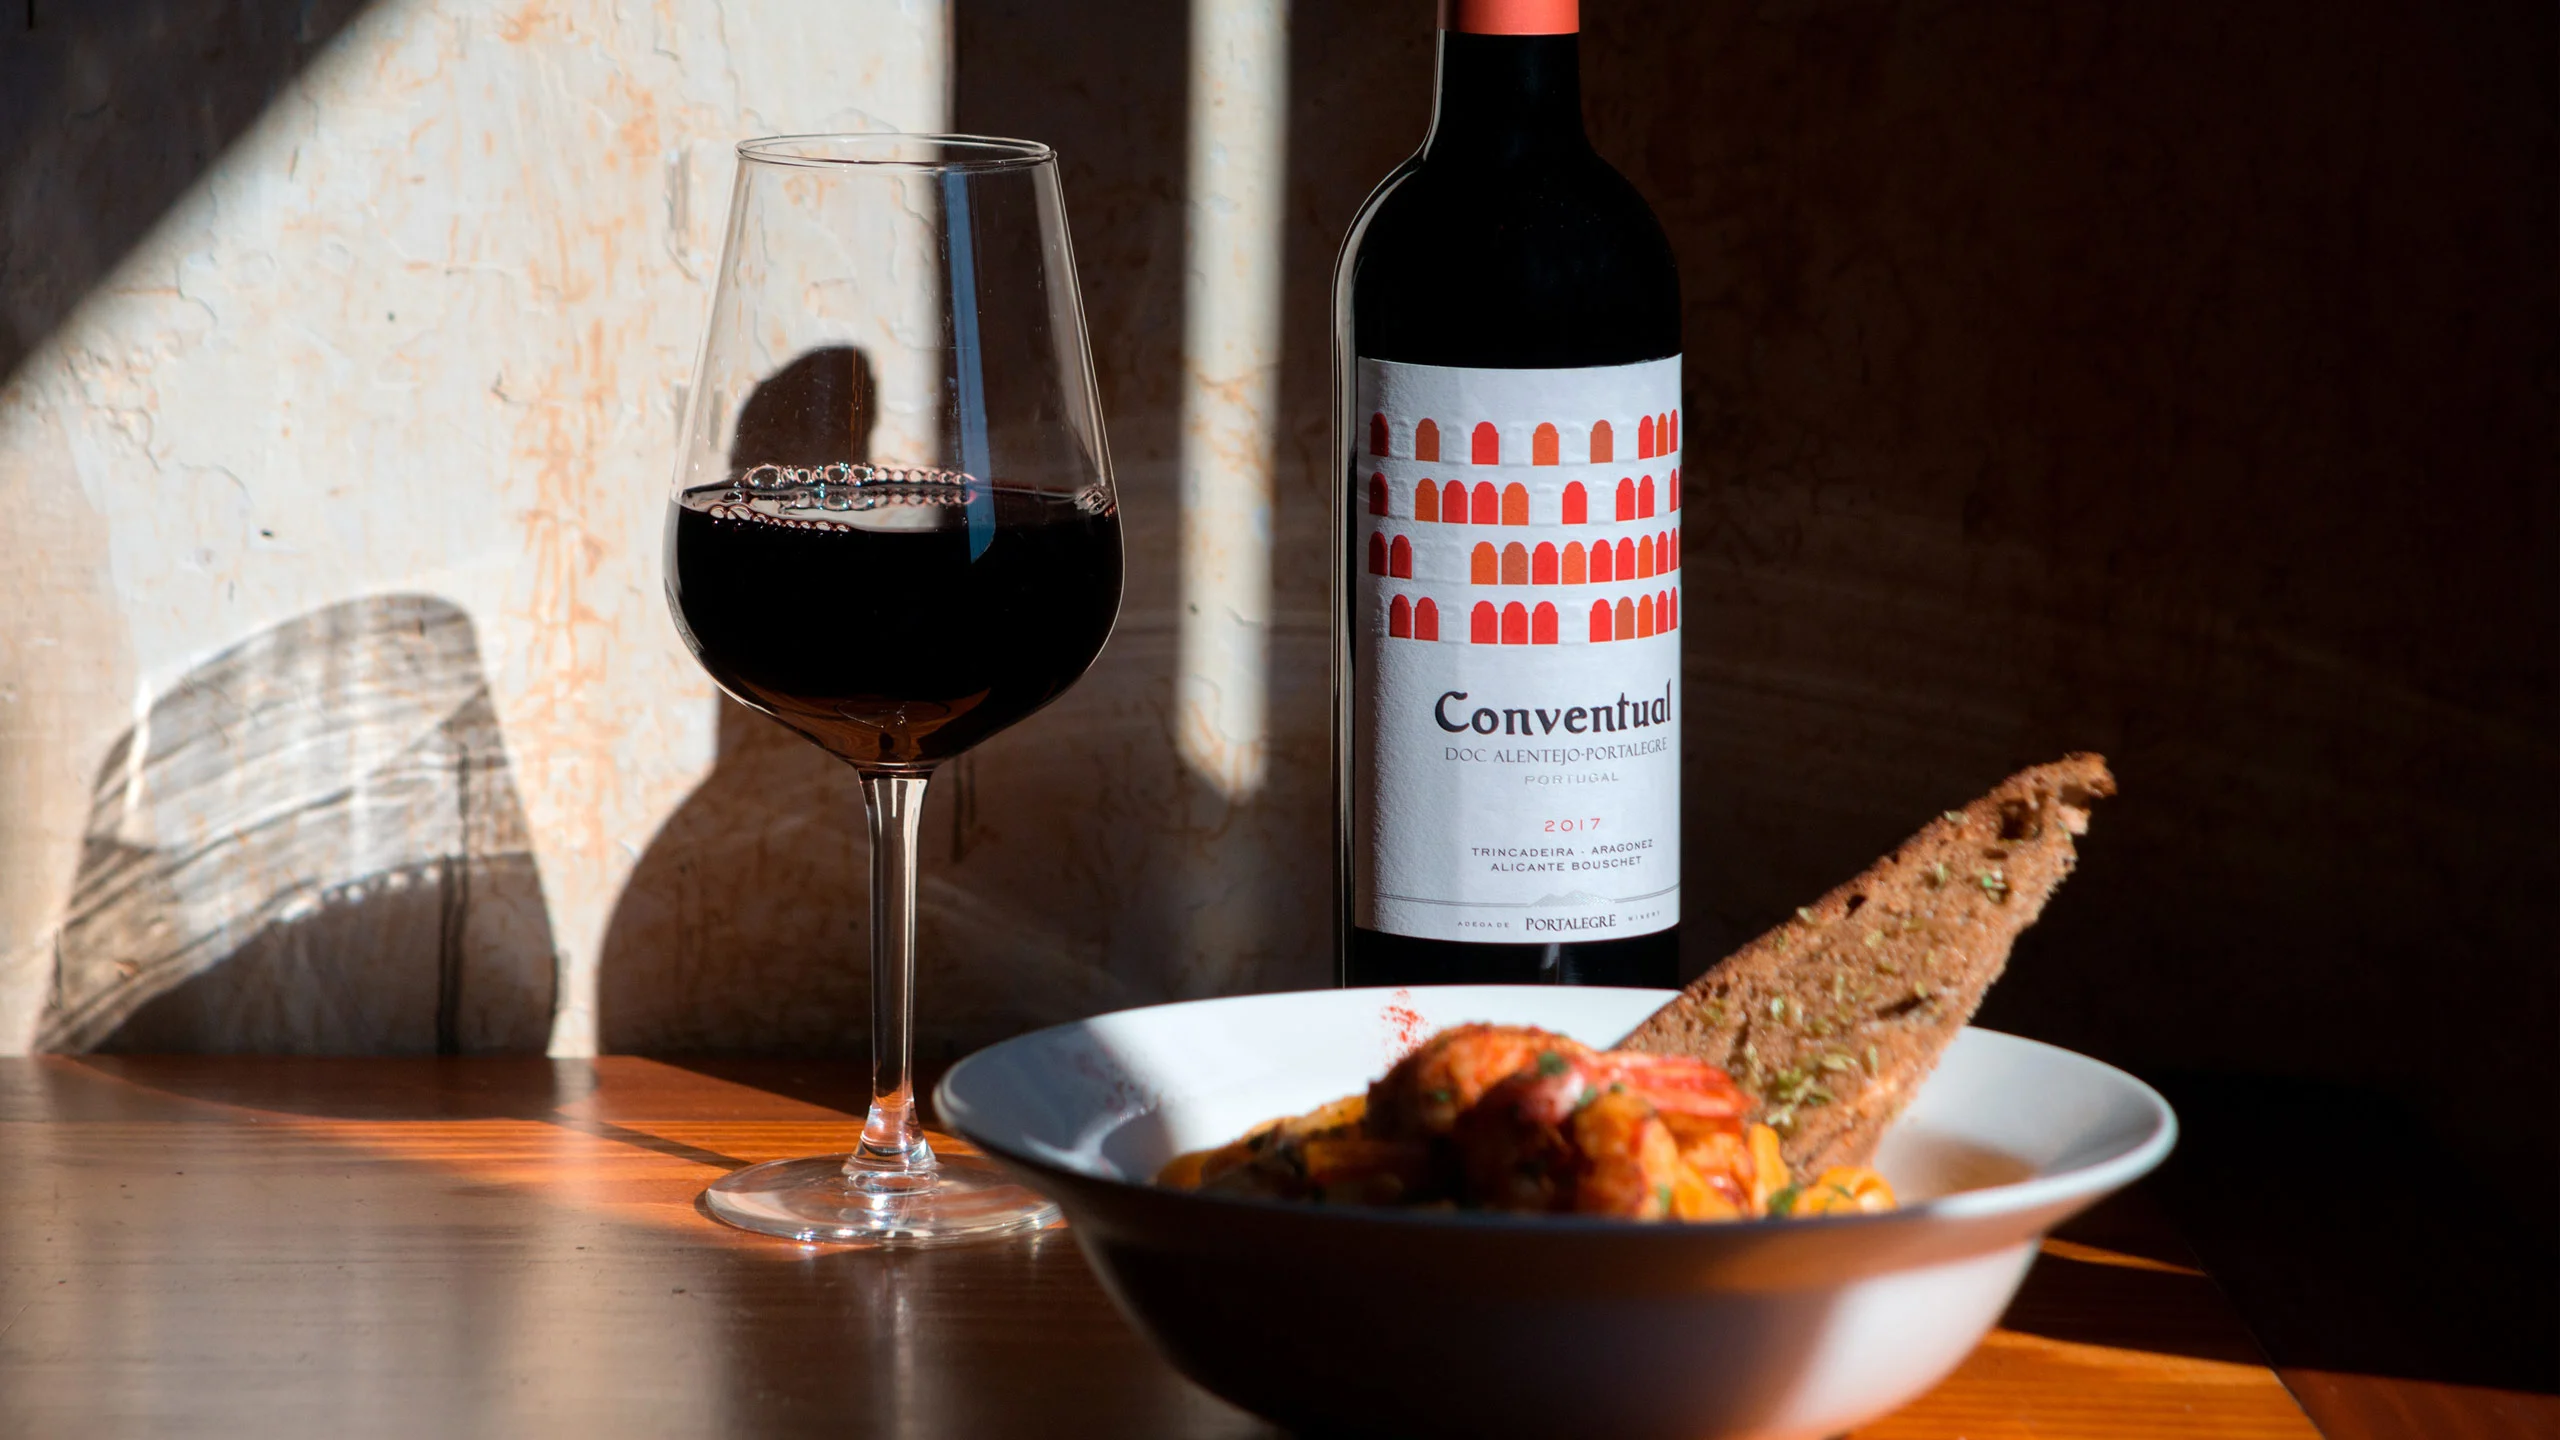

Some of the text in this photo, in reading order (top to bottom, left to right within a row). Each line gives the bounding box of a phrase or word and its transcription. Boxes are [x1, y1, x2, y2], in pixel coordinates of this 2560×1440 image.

[1435, 678, 1672, 736] Conventual
[1445, 737, 1668, 766] DOC ALENTEJO-PORTALEGRE
[1524, 772, 1620, 785] PORTUGAL
[1544, 818, 1601, 832] 2017
[1471, 847, 1575, 857] TRINCADEIRA
[1591, 839, 1654, 854] ARAGONEZ
[1490, 856, 1642, 872] ALICANTE BOUSCHET
[1525, 914, 1617, 932] PORTALEGRE
